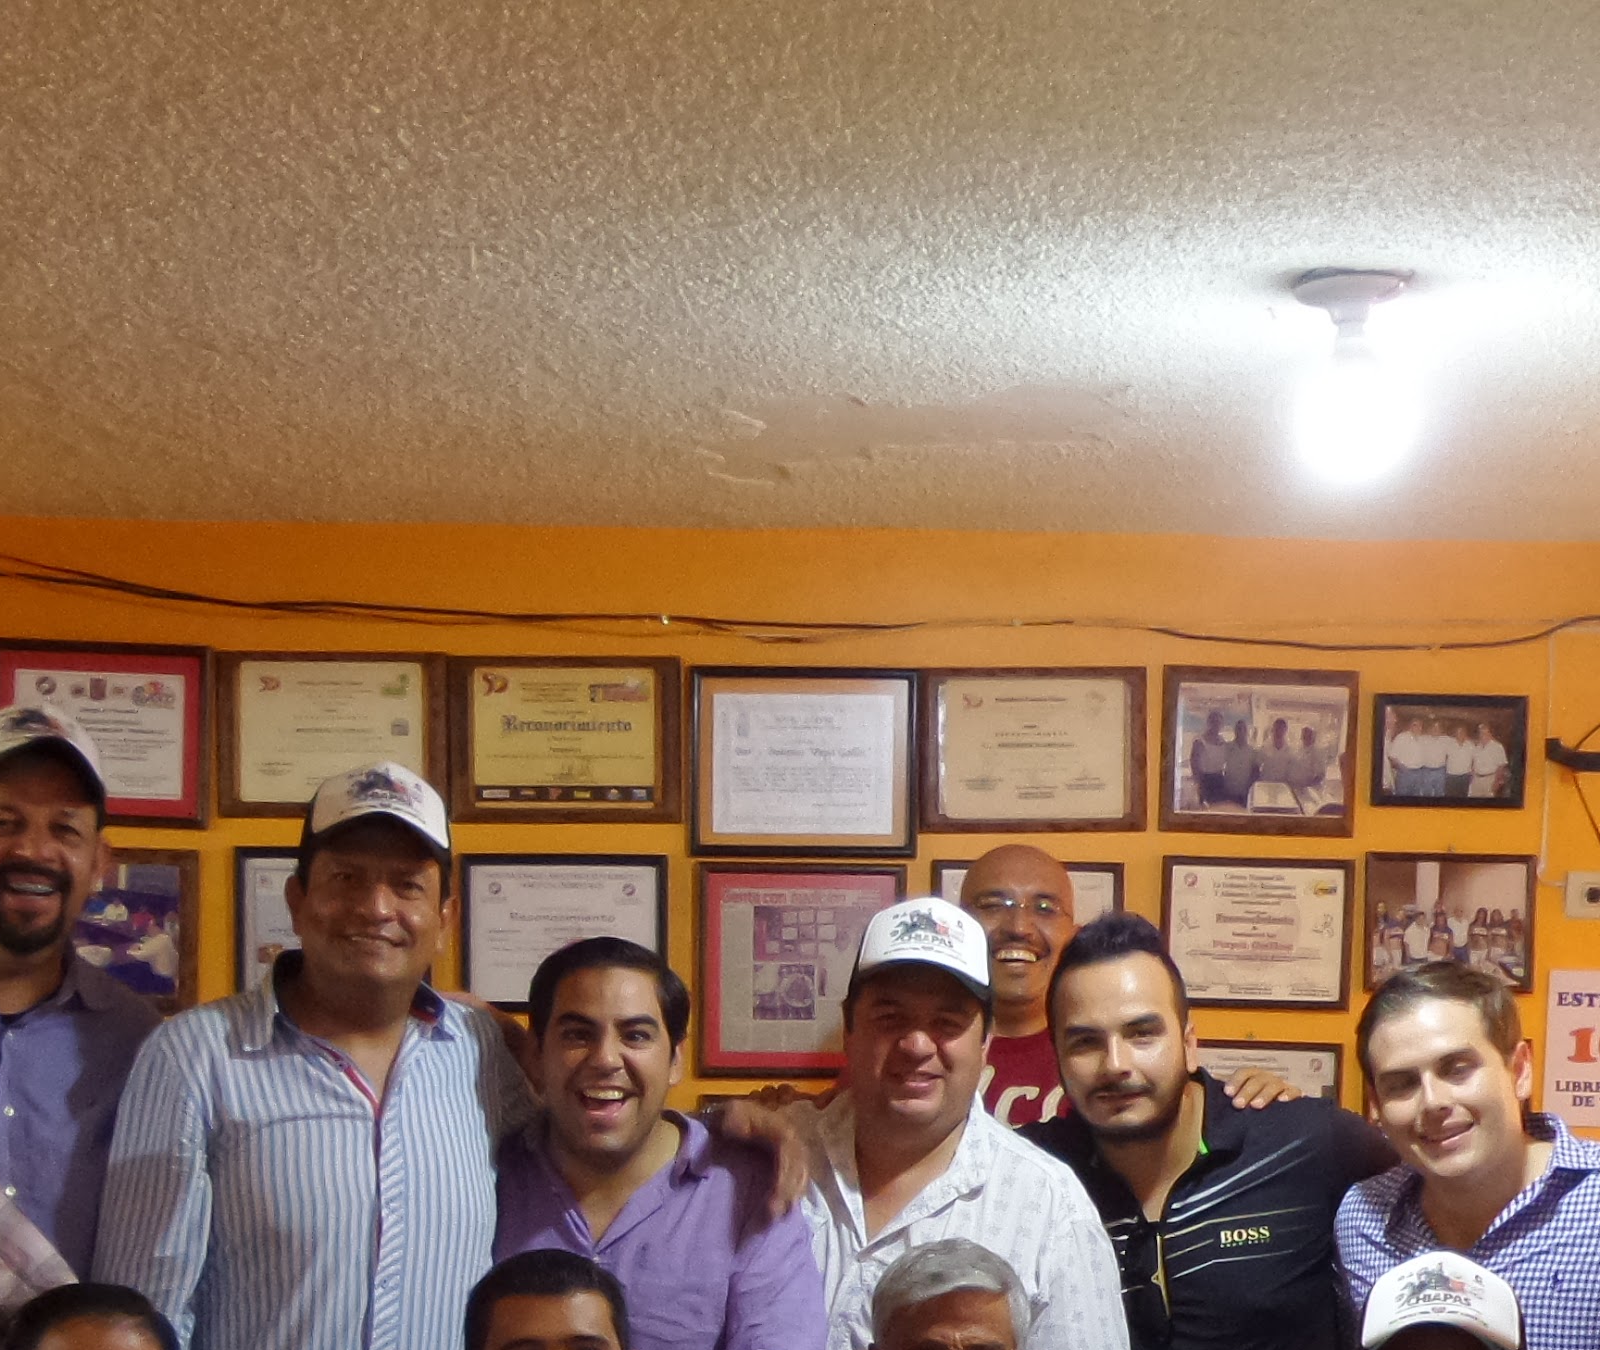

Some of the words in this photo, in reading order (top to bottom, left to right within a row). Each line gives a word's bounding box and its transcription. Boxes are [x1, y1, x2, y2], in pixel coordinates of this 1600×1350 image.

[1572, 1095, 1595, 1108] DE
[1220, 1226, 1270, 1244] BOSS
[1406, 1293, 1472, 1307] CHIAPAS
